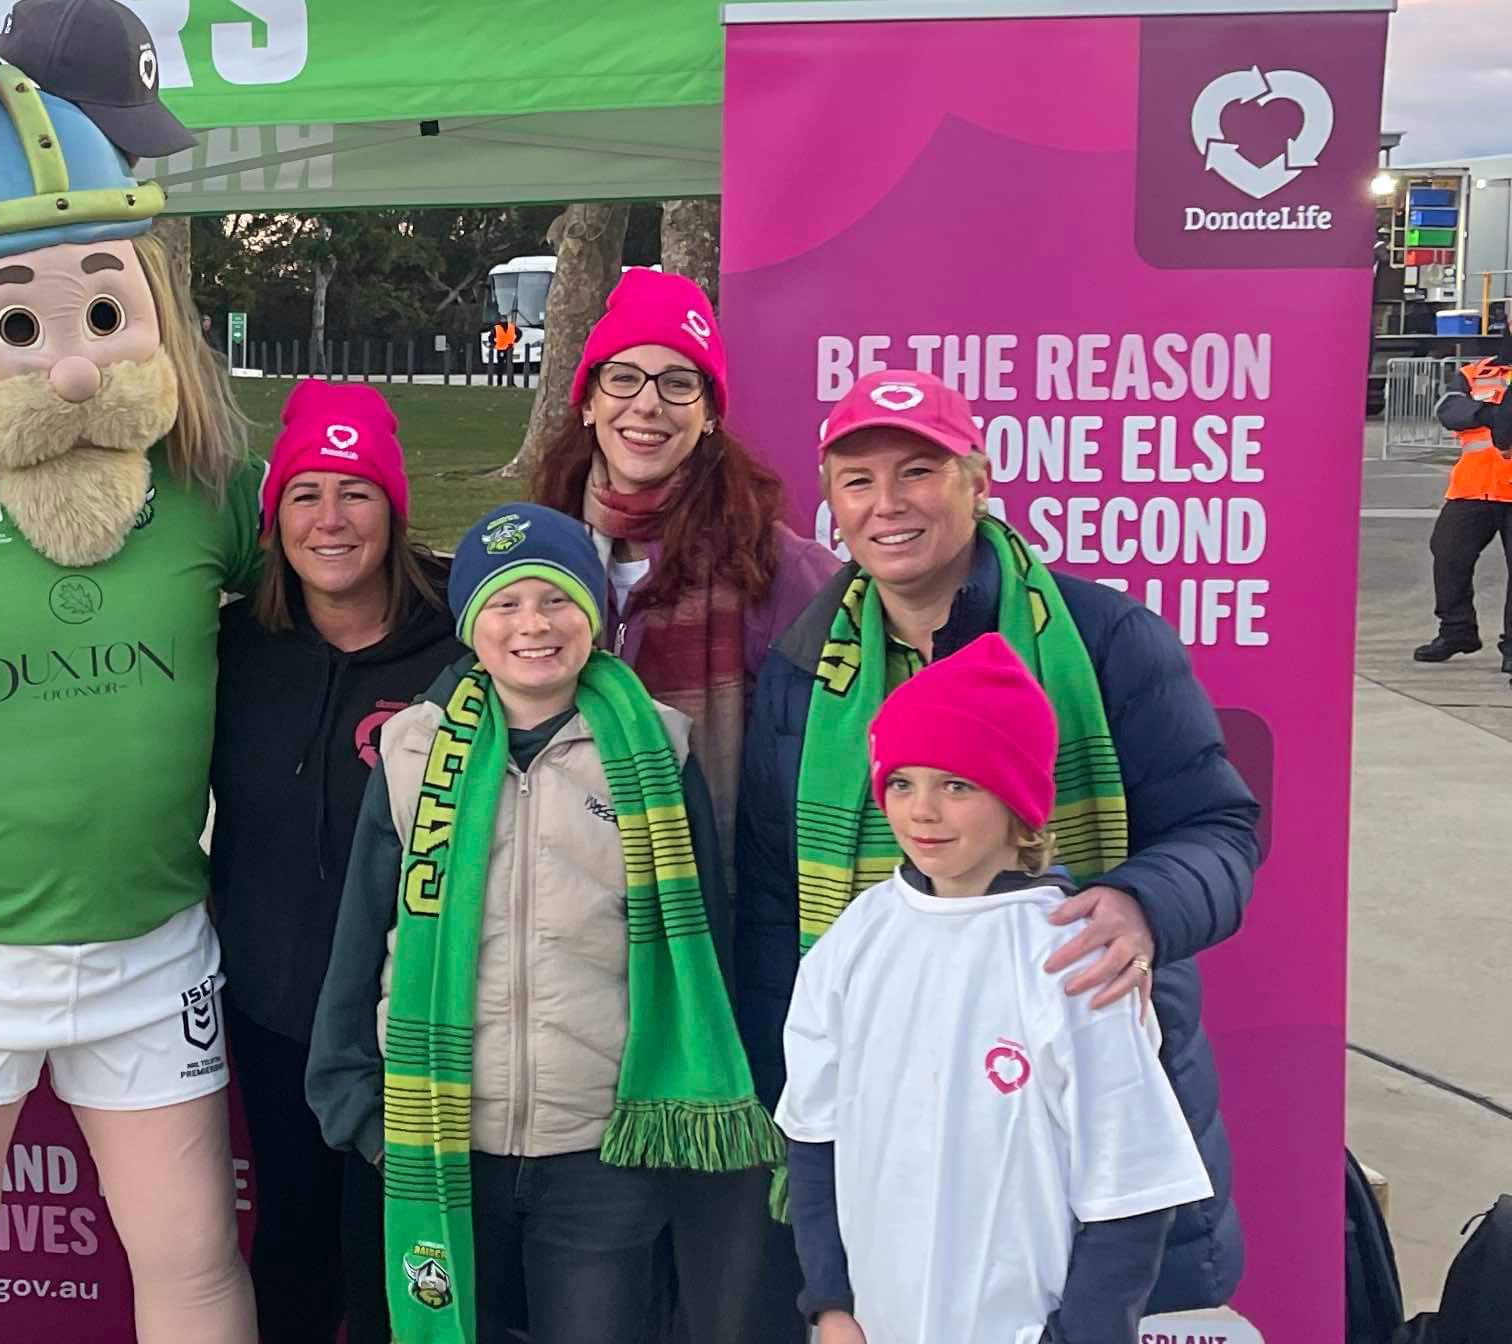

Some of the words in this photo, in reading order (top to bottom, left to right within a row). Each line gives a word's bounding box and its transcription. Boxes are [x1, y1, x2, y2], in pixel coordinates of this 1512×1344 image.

[1184, 206, 1332, 231] DonateLife
[816, 335, 891, 401] BE
[907, 334, 1017, 400] THE
[1036, 333, 1271, 401] REASON
[1120, 415, 1265, 483] ELSE
[1029, 497, 1267, 565] SECOND
